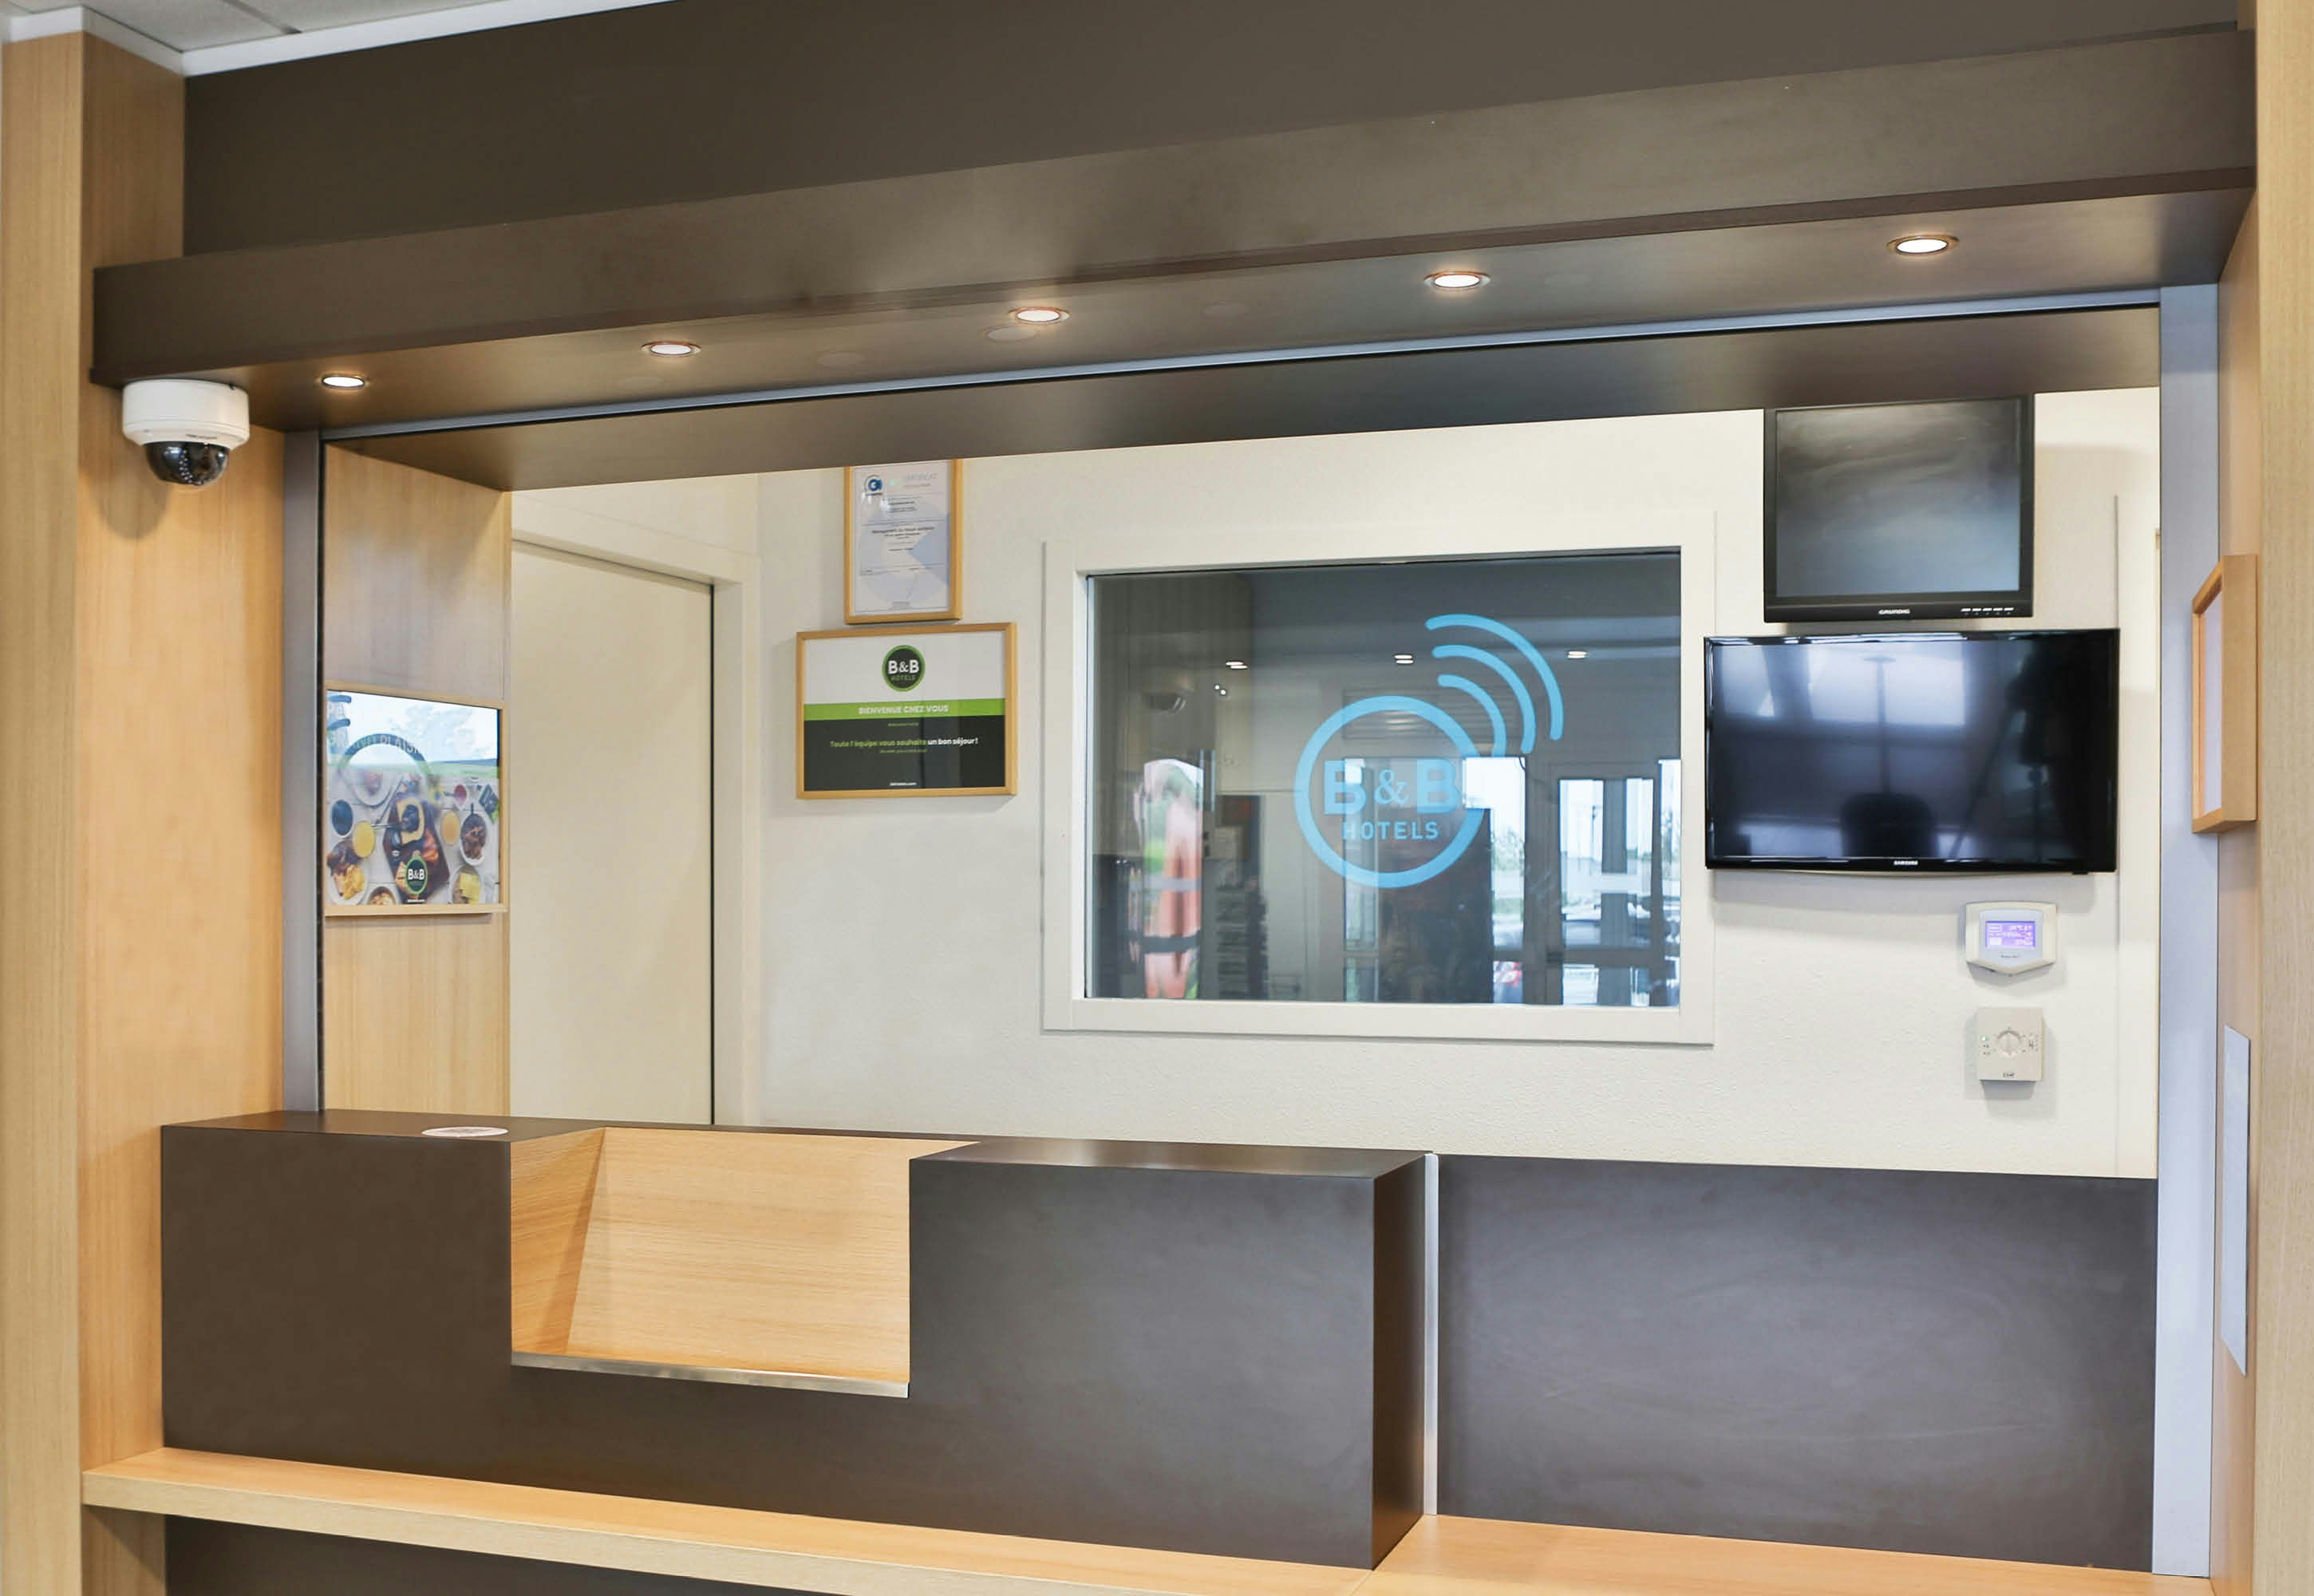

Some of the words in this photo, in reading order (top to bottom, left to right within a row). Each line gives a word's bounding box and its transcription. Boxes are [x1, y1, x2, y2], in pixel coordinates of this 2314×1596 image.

[888, 659, 919, 674] B&B
[859, 706, 902, 715] BIENVENUE
[903, 705, 925, 714] CHEZ
[926, 704, 950, 713] VOUS
[1324, 759, 1462, 815] B&B
[1342, 821, 1439, 840] HOTELS
[408, 868, 425, 880] B&B
